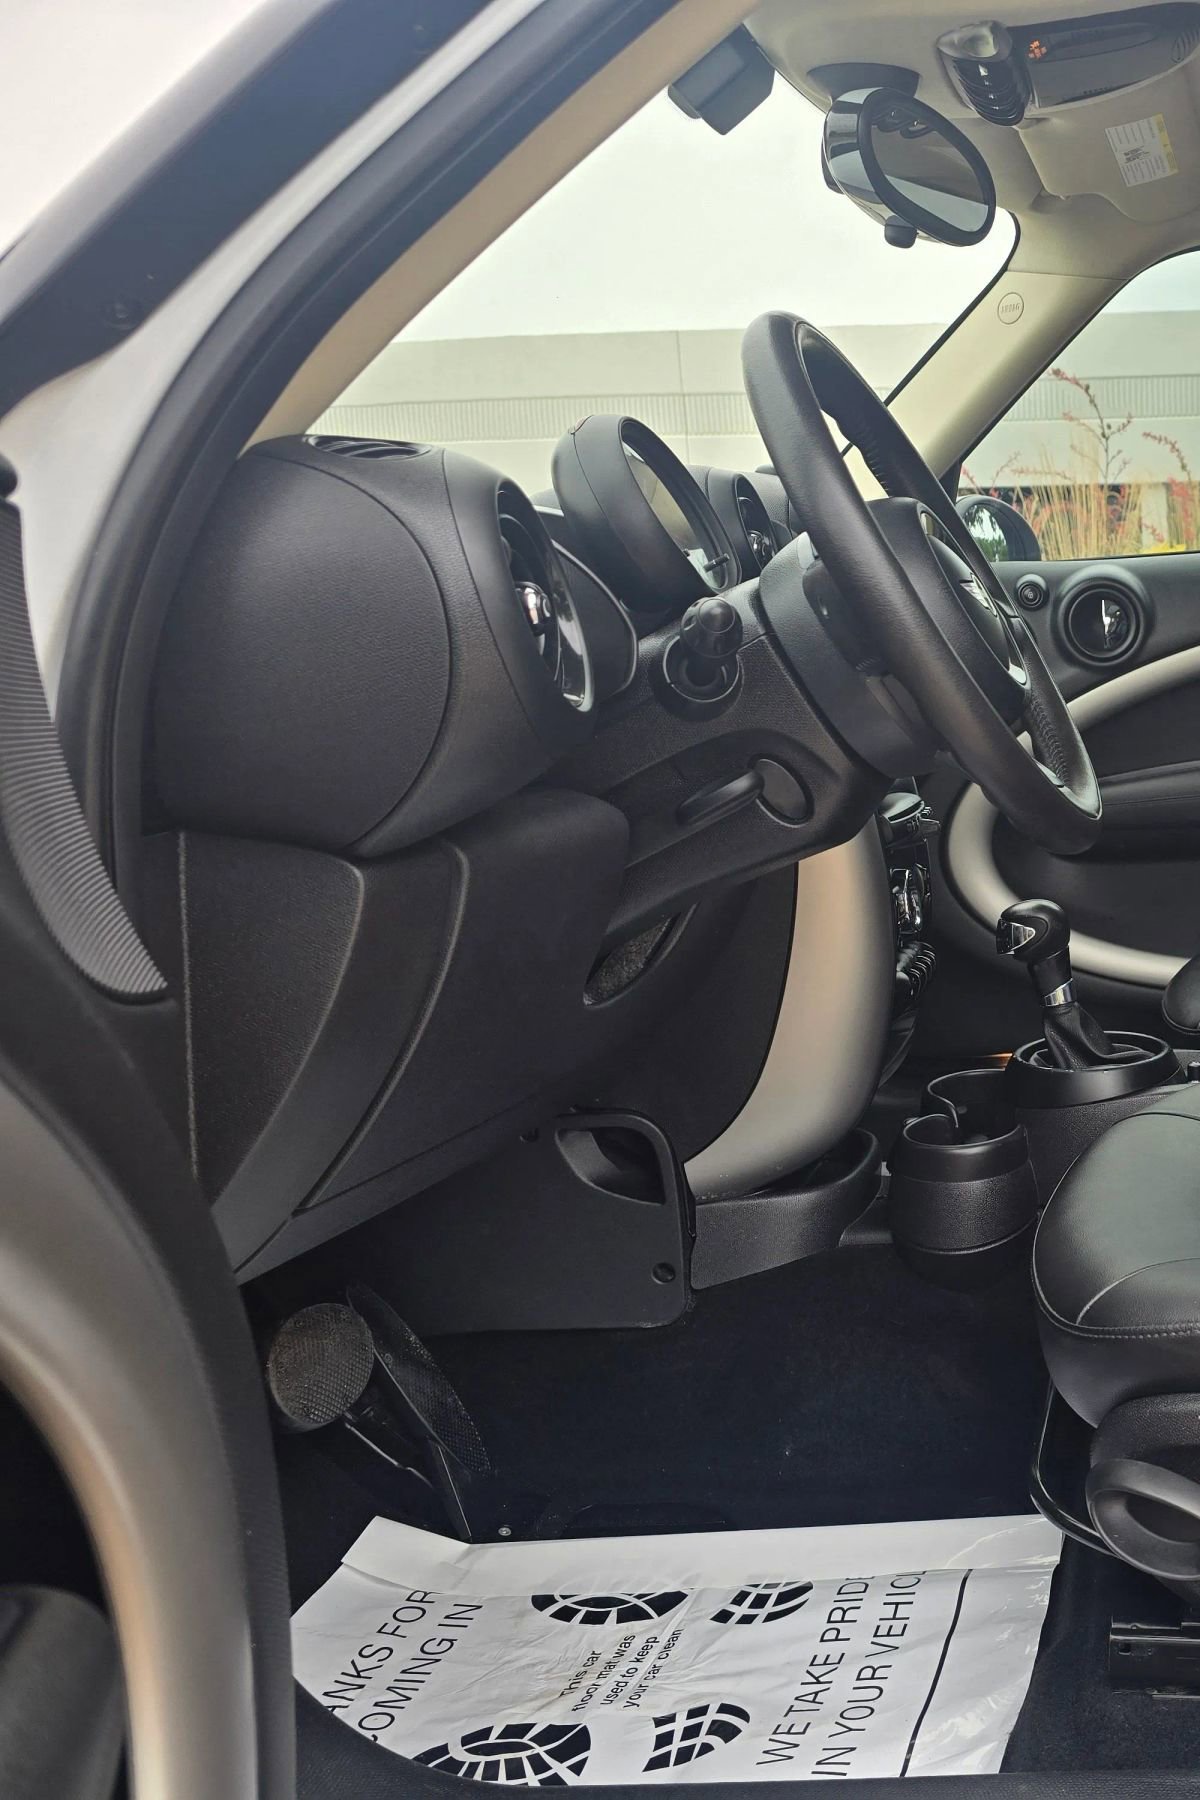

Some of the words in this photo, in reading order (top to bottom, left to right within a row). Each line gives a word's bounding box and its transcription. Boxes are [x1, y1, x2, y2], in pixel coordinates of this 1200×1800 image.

[376, 1590, 441, 1638] FOR
[358, 1638, 458, 1743] OMING
[437, 1603, 484, 1628] IN
[559, 1670, 588, 1698] This
[583, 1650, 602, 1668] car
[596, 1660, 621, 1680] mat
[613, 1634, 636, 1659] was
[600, 1680, 629, 1705] used
[620, 1667, 638, 1679] to
[629, 1636, 660, 1663] keep
[623, 1683, 649, 1708] your
[644, 1664, 663, 1681] car
[657, 1629, 684, 1661] clean
[783, 1652, 846, 1718] TAKE
[828, 1664, 893, 1738] YOUR
[756, 1721, 812, 1766] WE
[811, 1747, 857, 1777] IN
